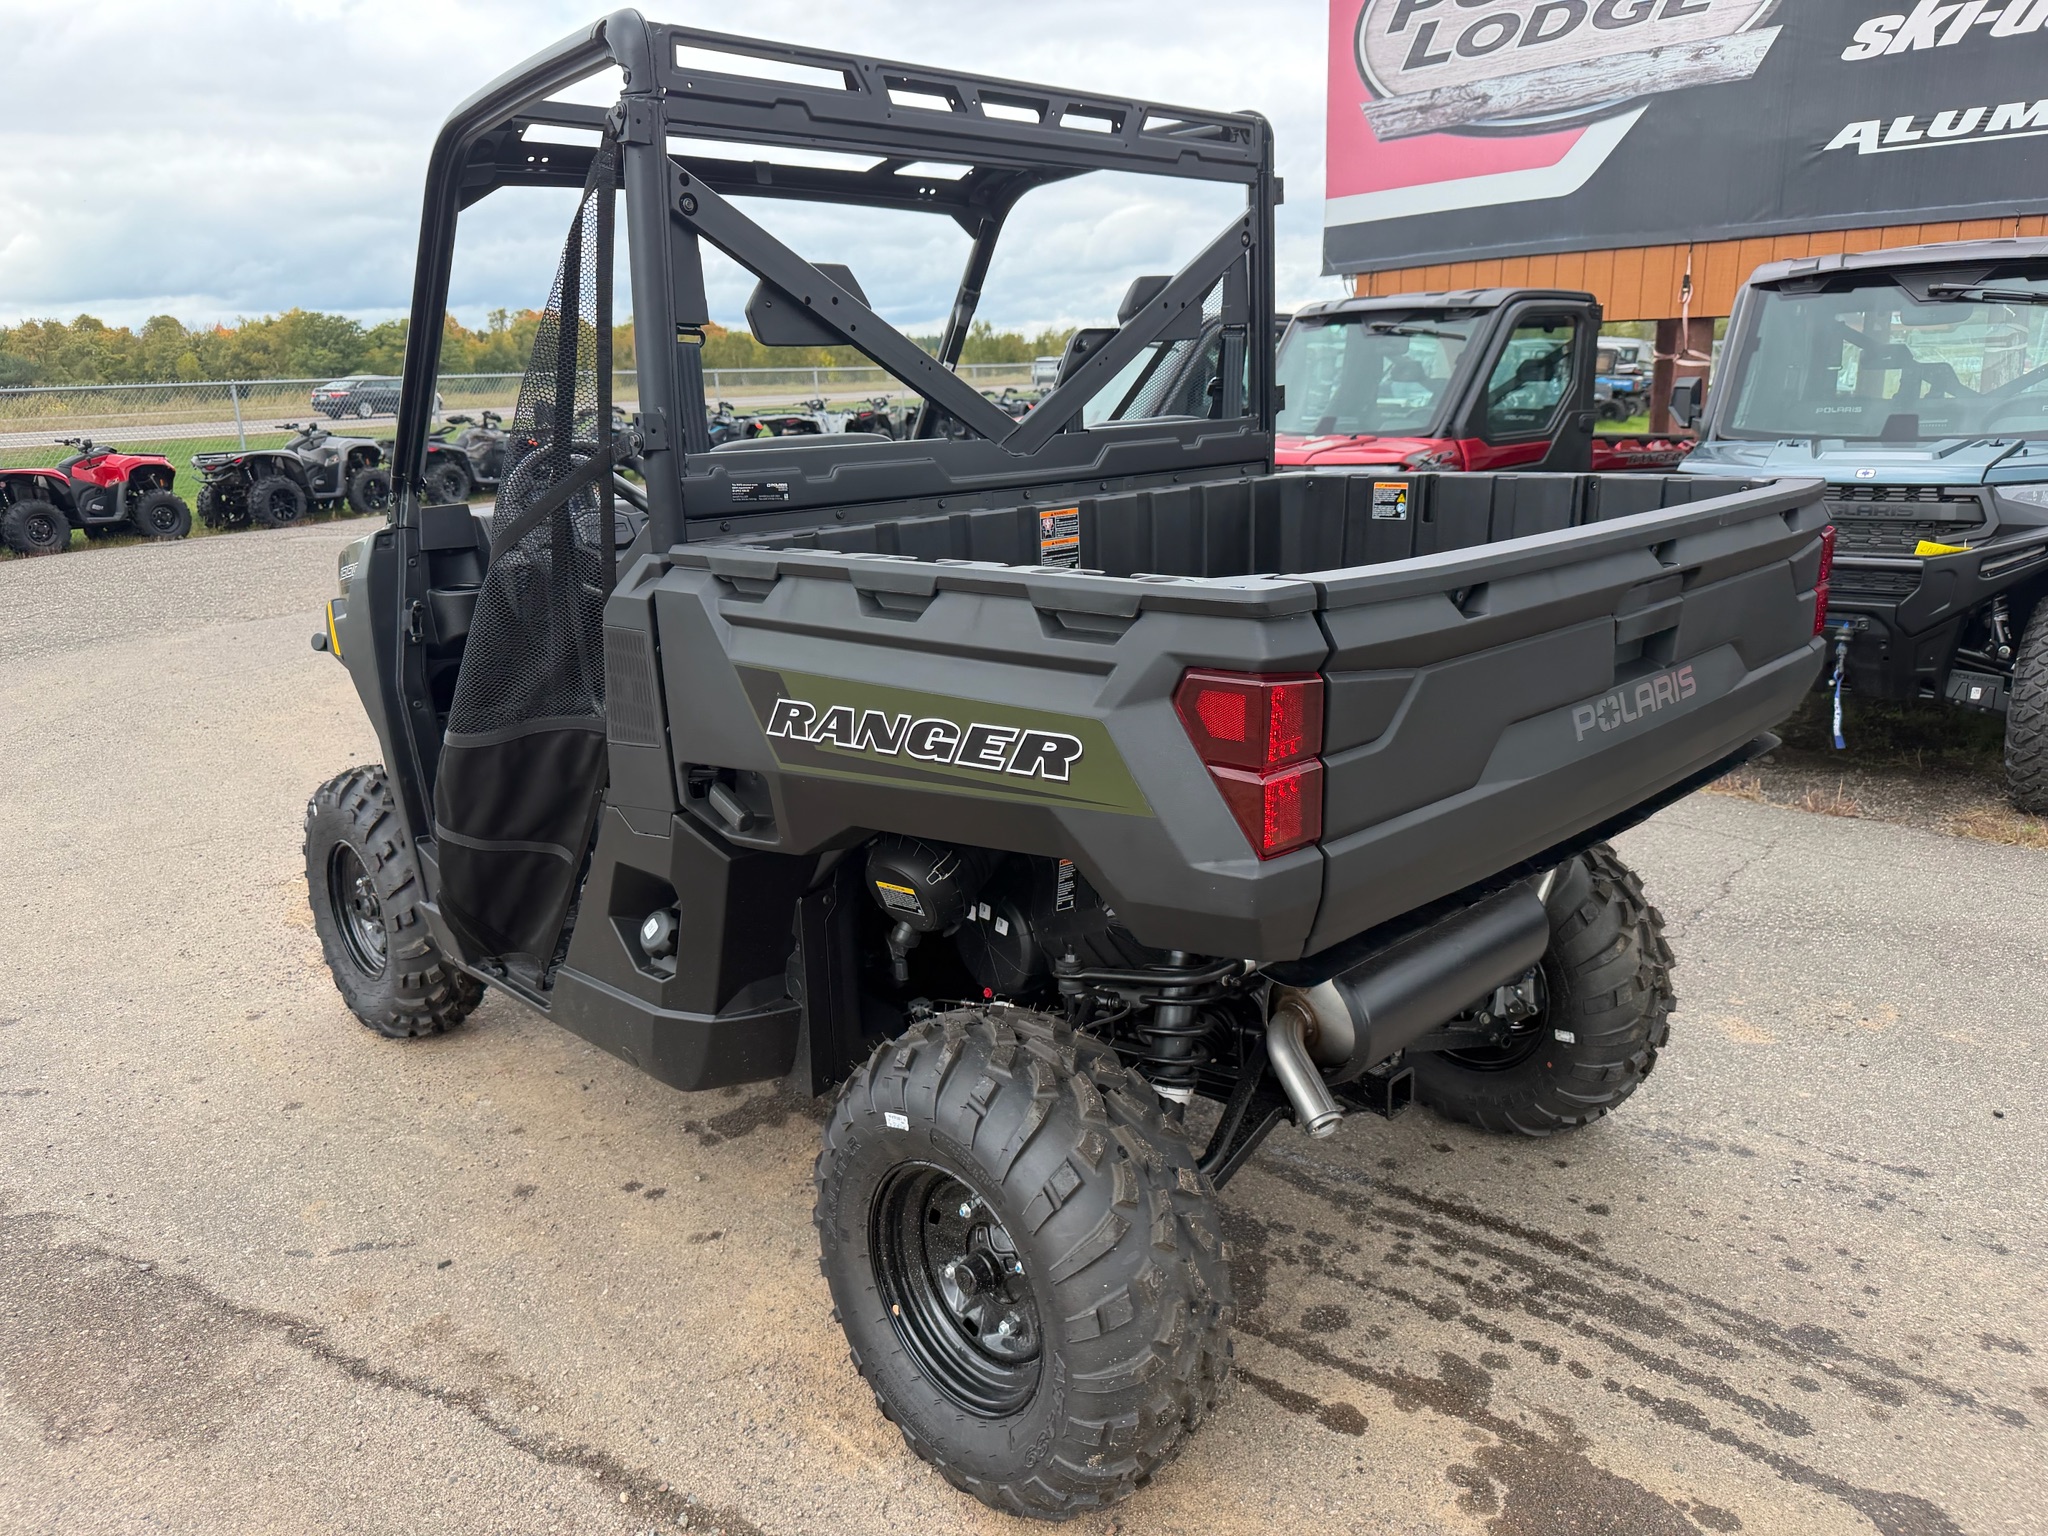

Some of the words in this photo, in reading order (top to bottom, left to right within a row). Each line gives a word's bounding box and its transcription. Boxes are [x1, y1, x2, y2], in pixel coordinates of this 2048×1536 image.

[1816, 406, 1862, 414] POLARIS
[1828, 504, 1914, 517] OLARIS
[1572, 665, 1697, 742] POLARIS
[766, 698, 1083, 781] RANGER
